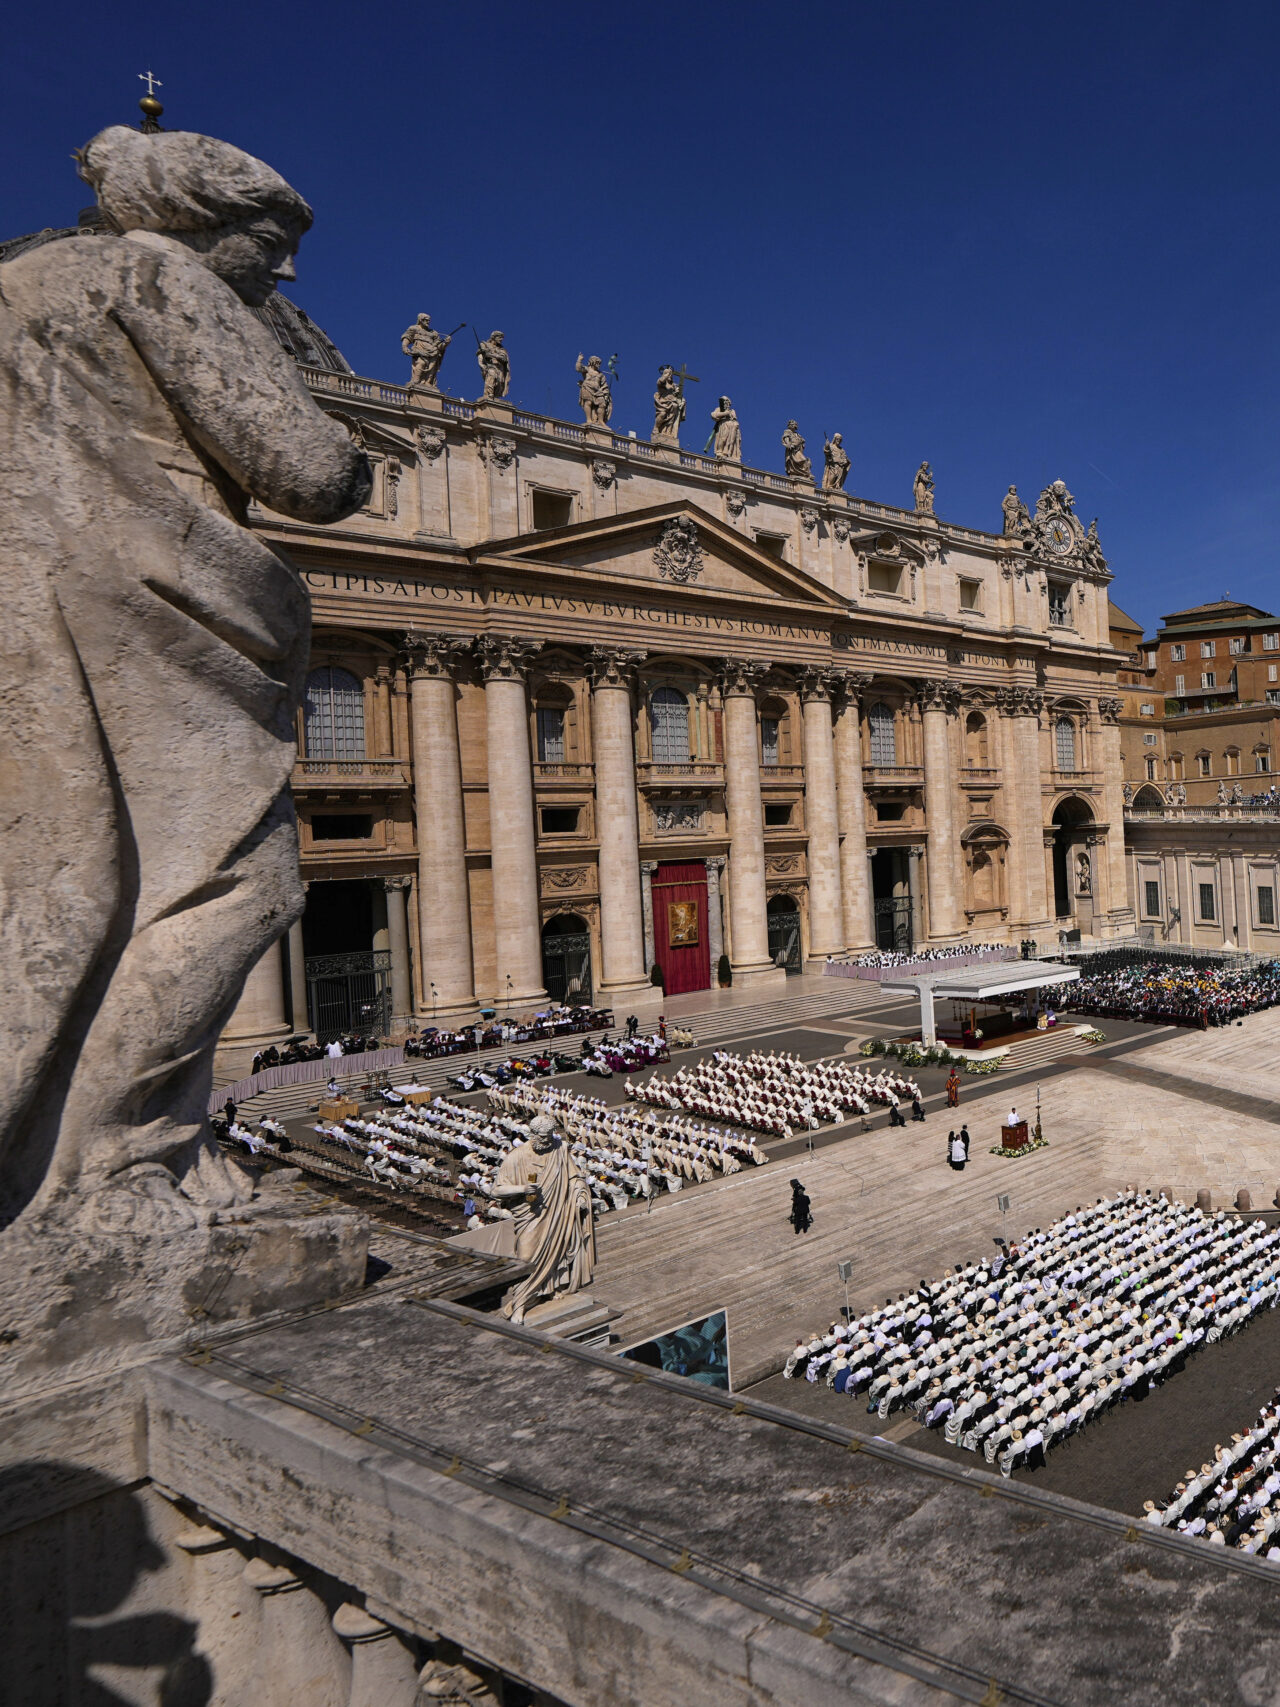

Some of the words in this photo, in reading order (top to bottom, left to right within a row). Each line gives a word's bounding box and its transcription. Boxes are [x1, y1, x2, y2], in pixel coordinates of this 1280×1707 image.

[296, 568, 384, 594] CIPIS
[391, 579, 481, 604] APOST
[492, 586, 577, 612] PAVLVS
[582, 598, 596, 614] V
[602, 600, 734, 631] BVRGHESIVS
[740, 618, 830, 642] ROMANVS
[870, 636, 902, 653] MAX
[903, 641, 923, 655] AN
